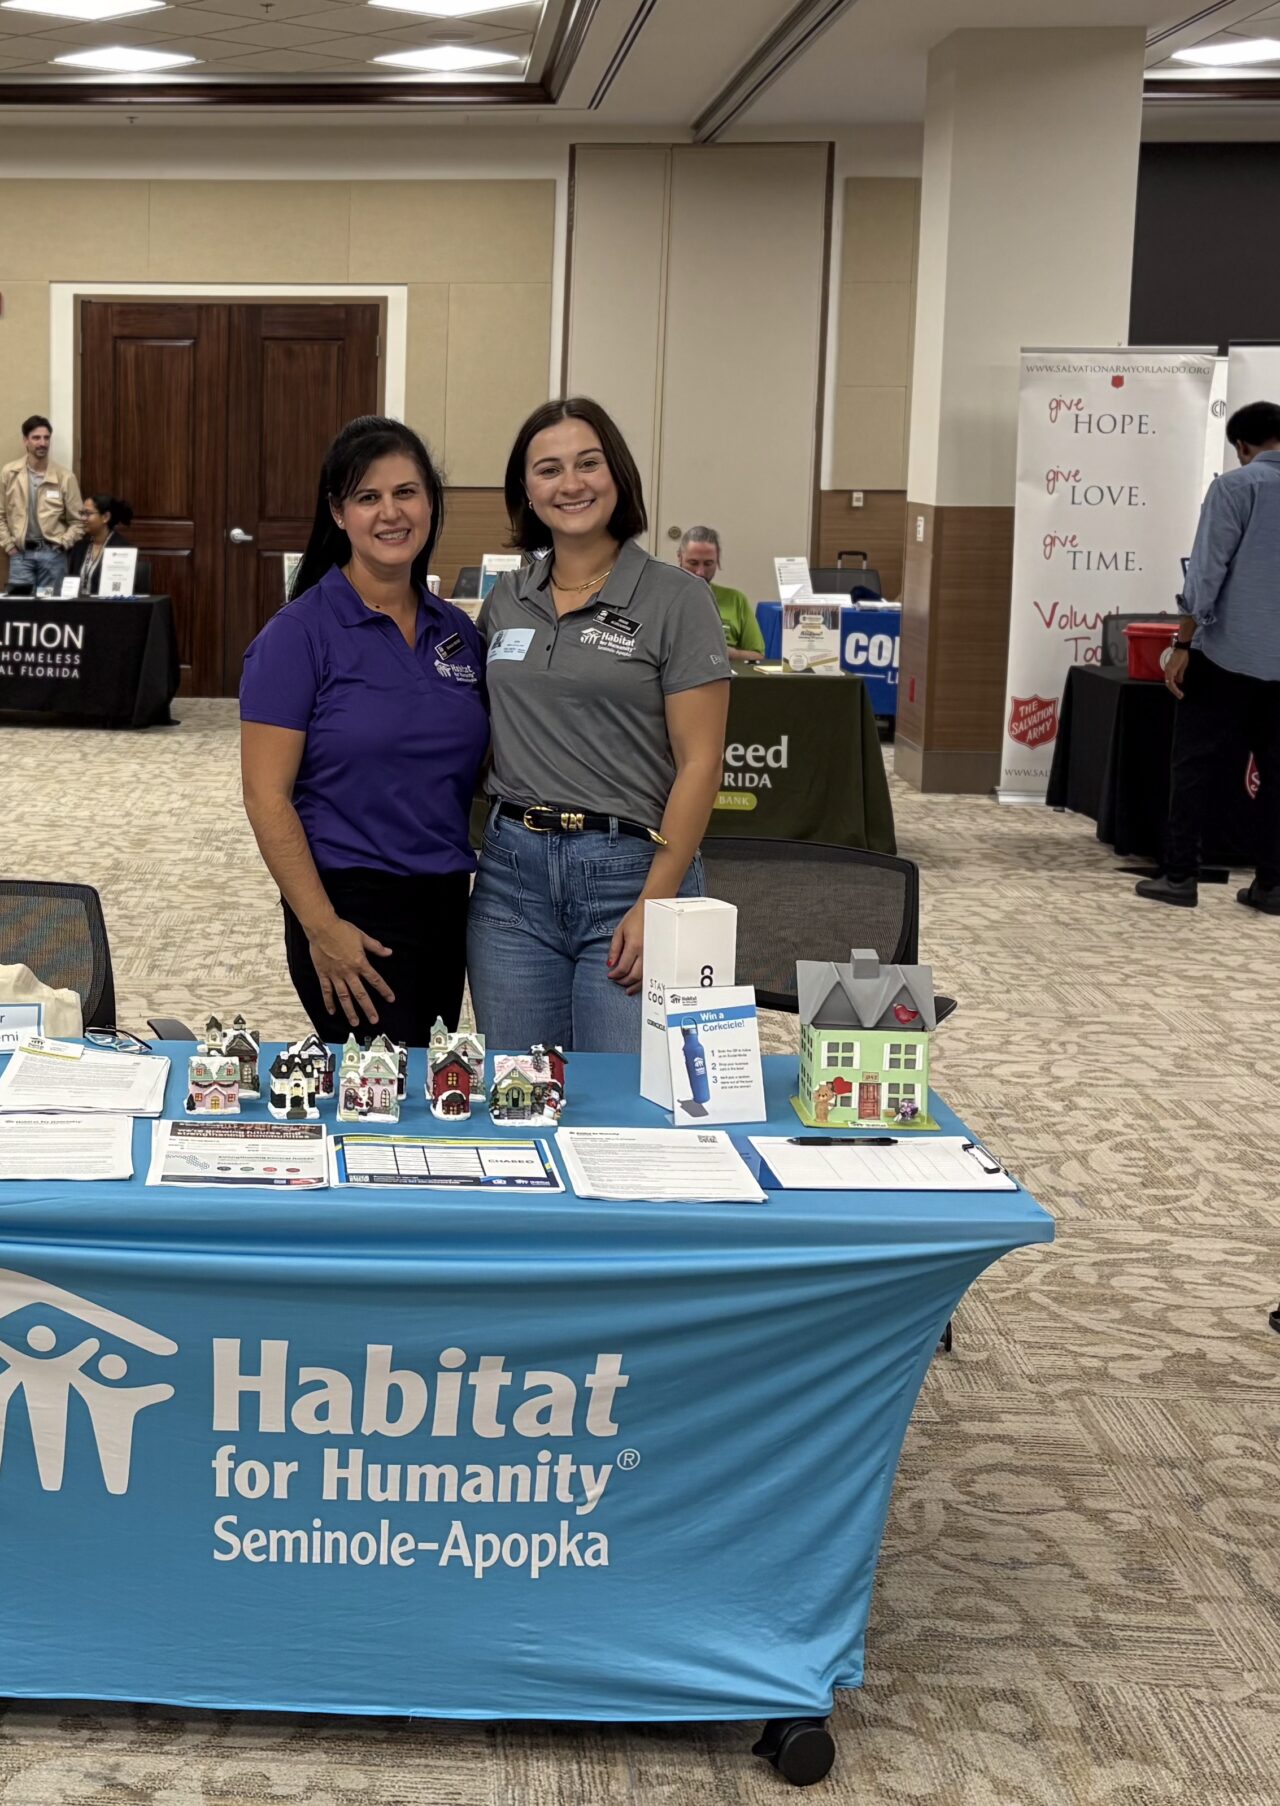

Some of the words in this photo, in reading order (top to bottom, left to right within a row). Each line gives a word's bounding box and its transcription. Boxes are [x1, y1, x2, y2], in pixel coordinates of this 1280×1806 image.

[1026, 364, 1211, 376] WWW.SALVATIONARMYORLANDO.ORG
[1048, 395, 1084, 423] give
[1073, 413, 1156, 435] HOPE.
[1046, 466, 1082, 495] give
[1071, 485, 1146, 506] LOVE.
[1043, 530, 1079, 560] give
[1066, 550, 1143, 571] TIME.
[600, 632, 636, 647] Habitat
[1, 651, 81, 665] HOMELESS
[21, 666, 80, 679] FLORIDA
[1019, 700, 1039, 716] THE
[1011, 703, 1054, 735] SALVATION
[1026, 719, 1053, 742] ARMY
[723, 735, 789, 769] eed
[724, 772, 772, 788] RIDA
[719, 796, 749, 806] BANK
[650, 978, 665, 991] STAY
[648, 991, 664, 1005] COO
[700, 1012, 717, 1020] Win
[702, 1020, 745, 1032] Corkcicle!
[711, 1062, 717, 1070] 2
[712, 1075, 718, 1084] 3
[212, 1337, 629, 1439] Habitat
[212, 1445, 299, 1498] for
[213, 1514, 609, 1579] Seminole-Apopka
